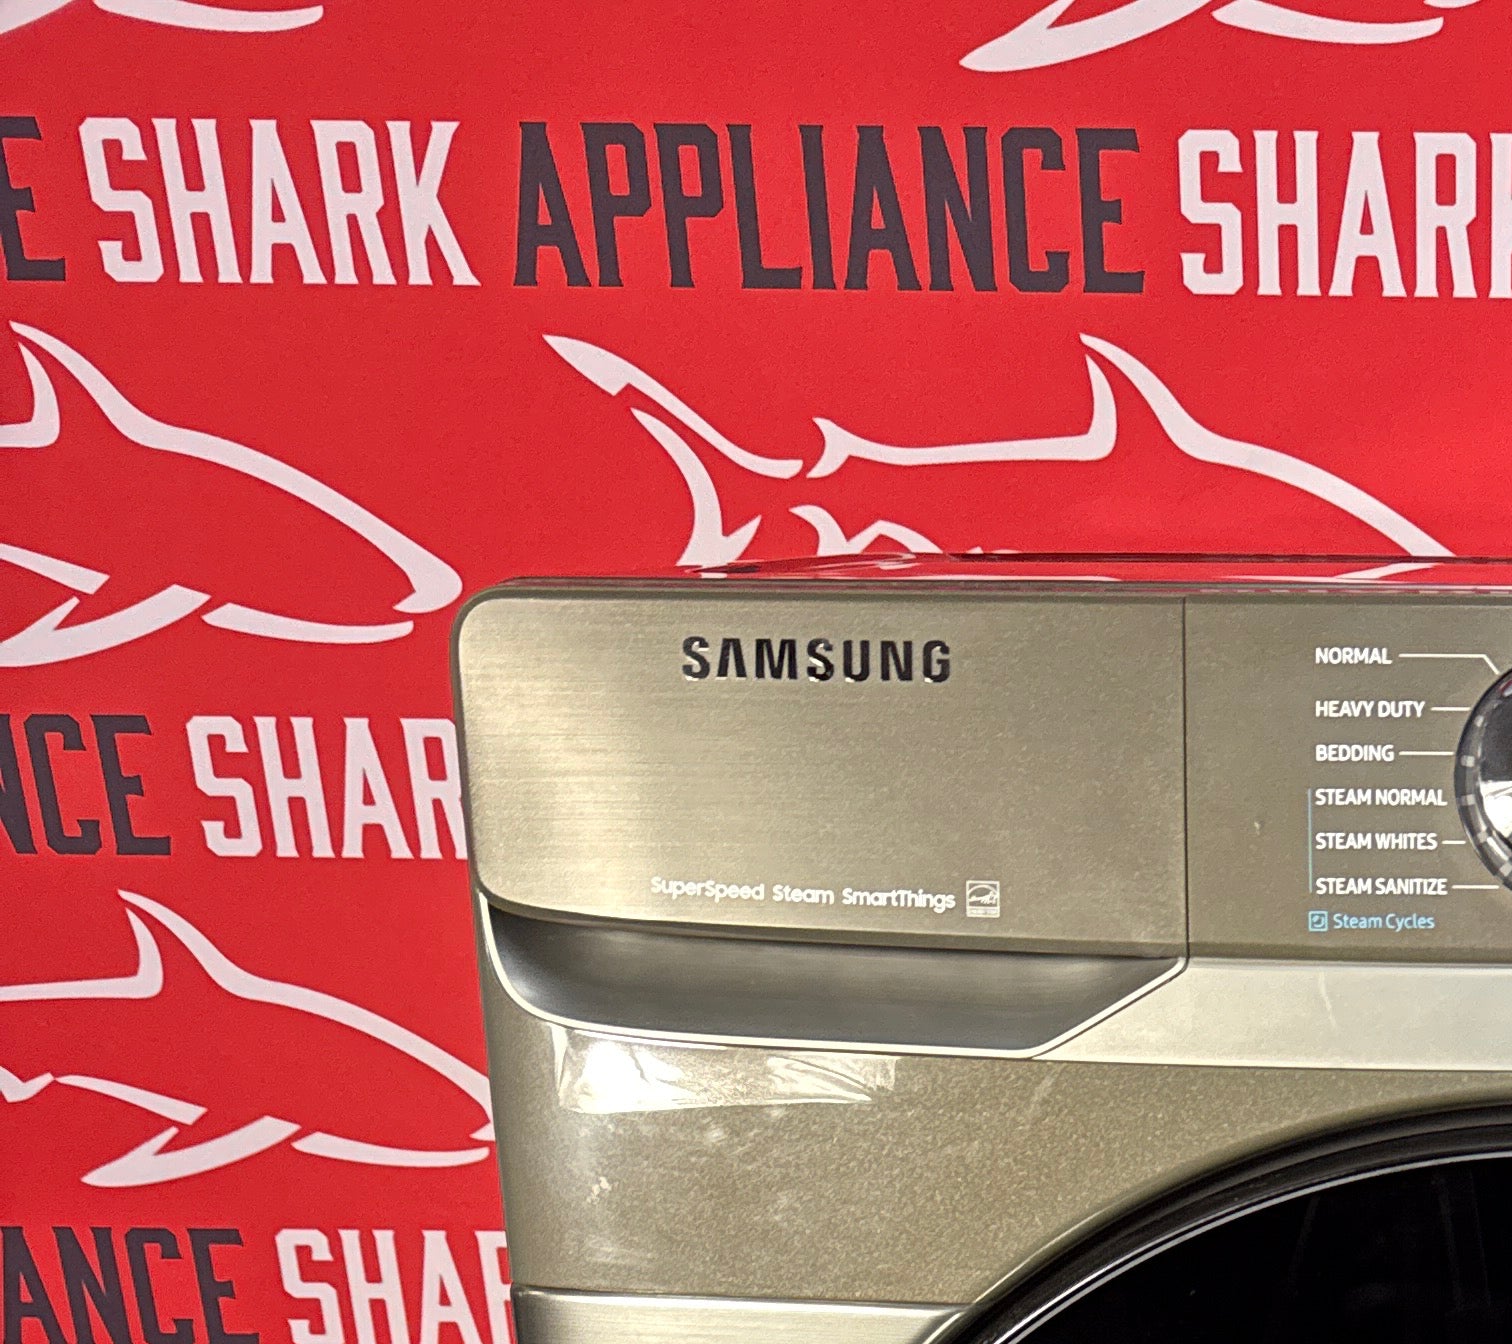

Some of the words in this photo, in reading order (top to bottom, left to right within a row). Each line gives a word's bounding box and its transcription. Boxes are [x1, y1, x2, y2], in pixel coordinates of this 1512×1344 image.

[79, 117, 480, 287] SHARK
[513, 121, 1146, 293] APPLIANCE
[682, 636, 951, 683] SAMSUNG
[1315, 647, 1392, 665] NORMAL
[1315, 700, 1374, 718] HEAVY
[1378, 700, 1425, 718] DUTY
[1315, 744, 1394, 762] BEDDING
[185, 715, 468, 860] SHAR
[1315, 788, 1370, 807] STEAM
[1375, 789, 1447, 807] NORMAL
[1315, 832, 1370, 850] STEAM
[1375, 832, 1437, 850] WHITES
[650, 876, 765, 903] SuperSpeed
[772, 884, 834, 905] Steam
[842, 888, 956, 914] SmartThings
[1315, 877, 1370, 896] STEAM
[1375, 878, 1448, 896] SANITIZE
[1333, 912, 1382, 930] Steam
[1386, 912, 1435, 932] Cycles
